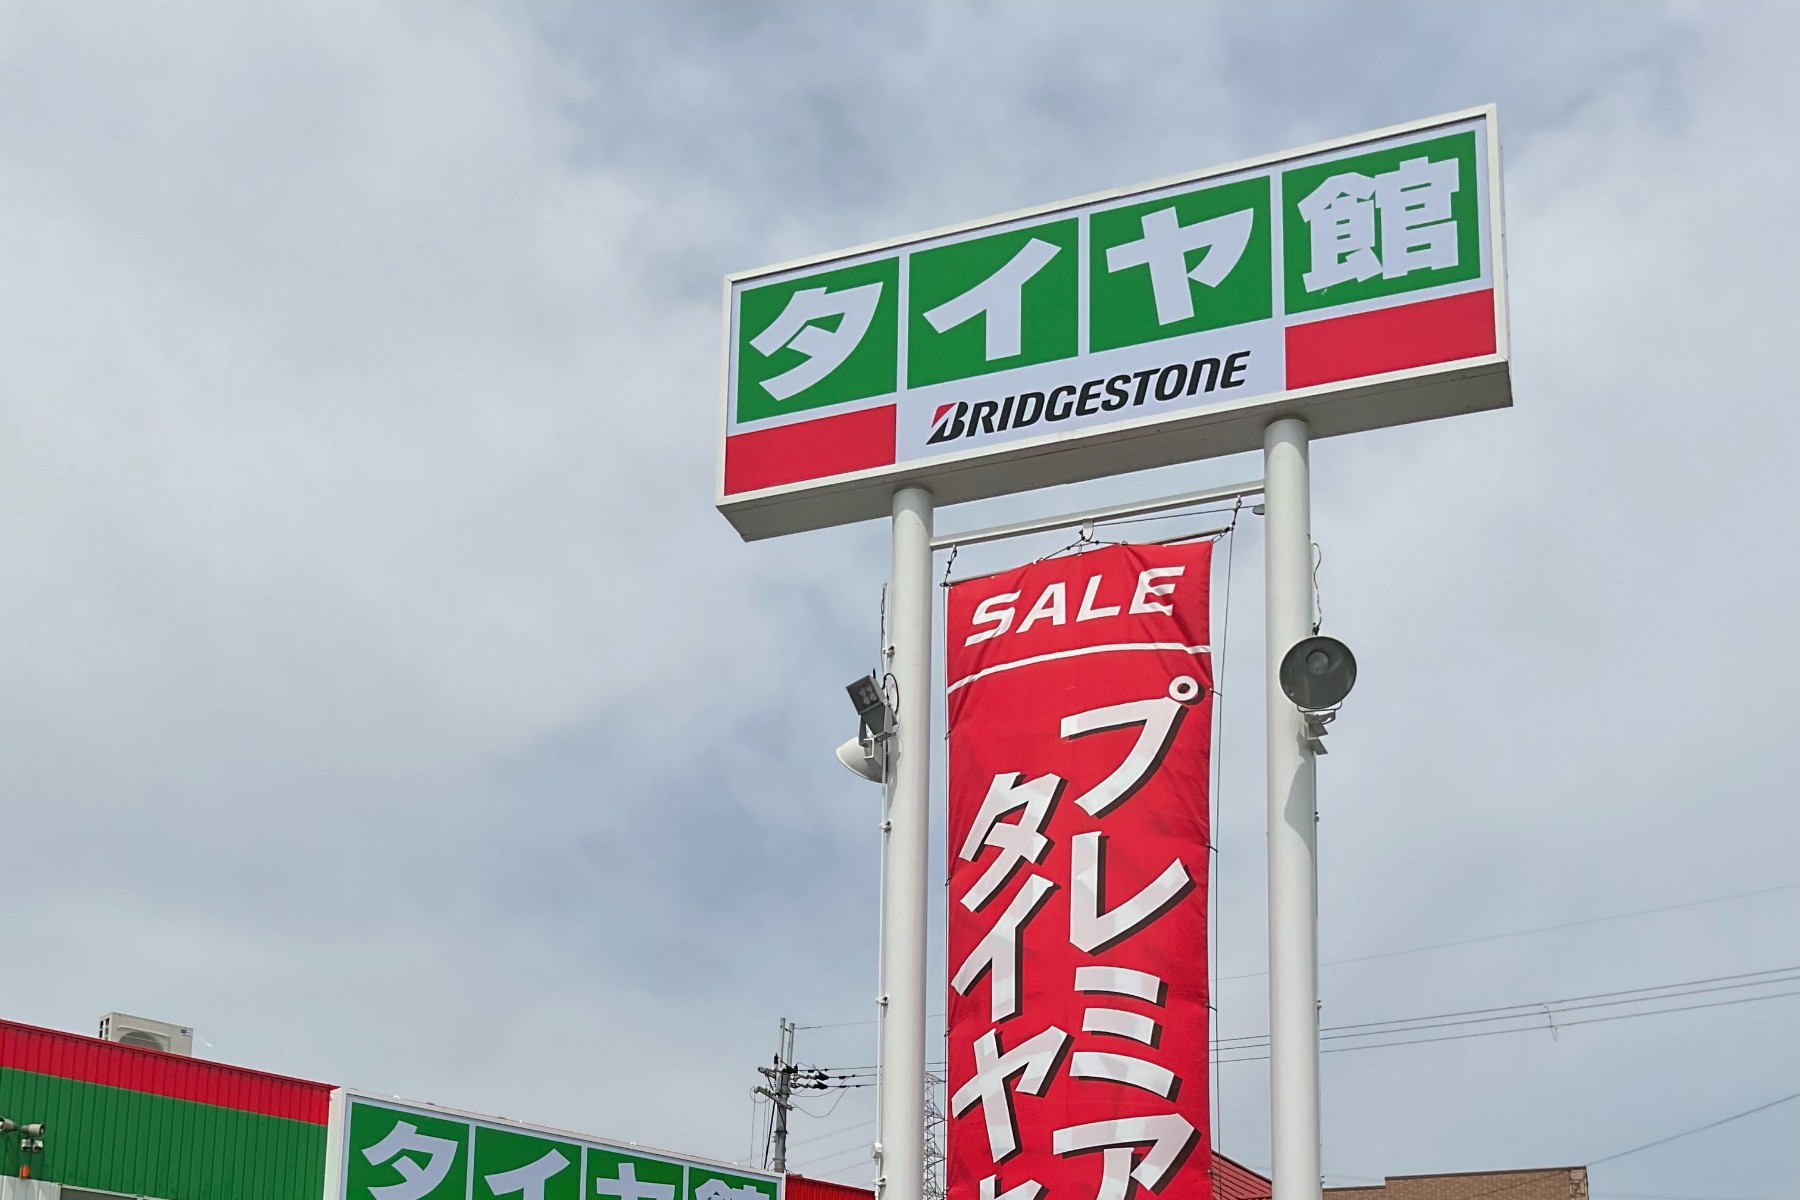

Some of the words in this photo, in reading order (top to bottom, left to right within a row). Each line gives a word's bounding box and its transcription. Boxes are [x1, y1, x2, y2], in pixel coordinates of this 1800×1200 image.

[749, 156, 1460, 401] タイヤ館
[926, 350, 1250, 445] BRIDGESTONE
[963, 565, 1186, 647] SALE
